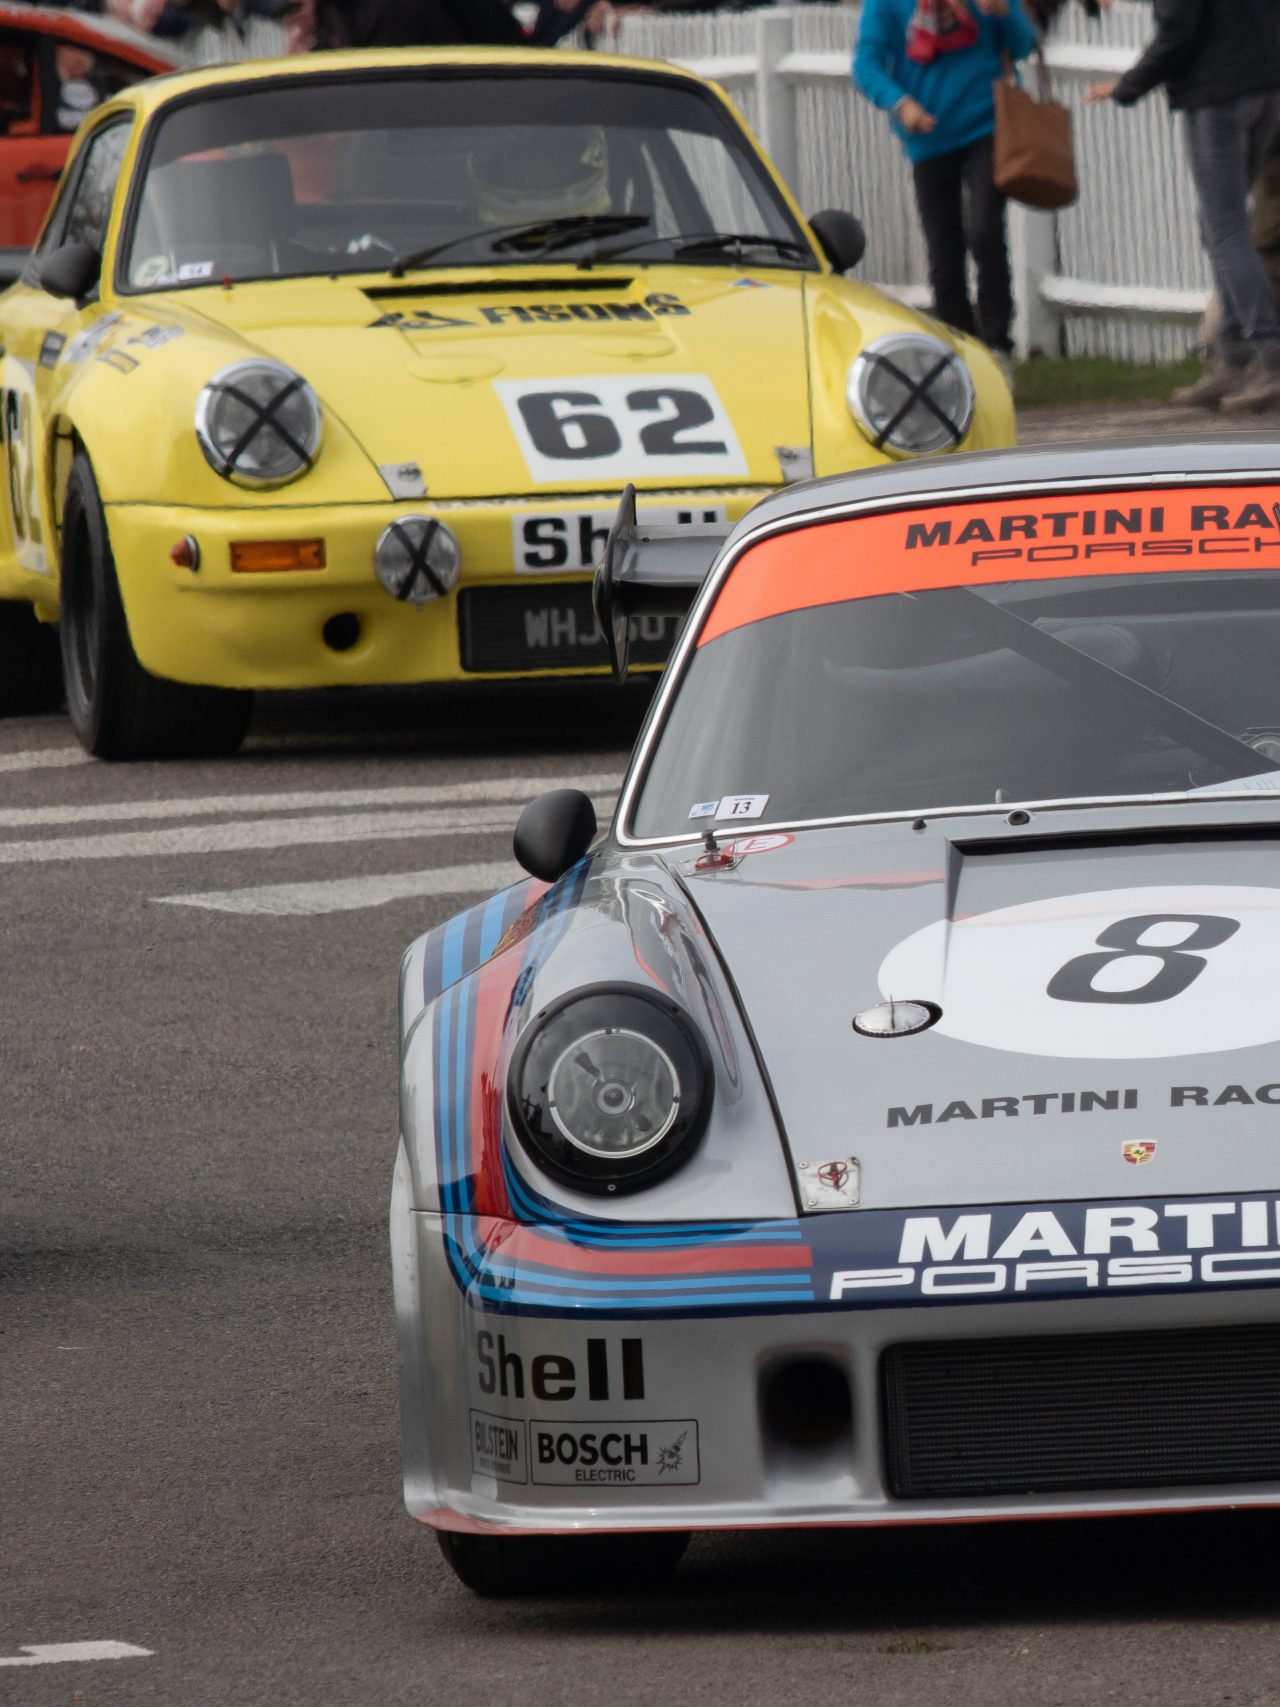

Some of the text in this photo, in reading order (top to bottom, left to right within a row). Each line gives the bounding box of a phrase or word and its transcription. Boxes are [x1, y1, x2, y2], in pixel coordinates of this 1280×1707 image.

[477, 292, 691, 325] FISONS
[516, 388, 729, 460] 62
[905, 505, 1165, 550] MARTINI
[731, 801, 752, 815] 13
[1046, 913, 1241, 1005] 8
[886, 1088, 1139, 1128] MARTINI
[477, 1330, 645, 1401] Shell
[475, 1421, 518, 1461] BILSTEIN
[537, 1432, 649, 1466] BOSCH
[575, 1469, 636, 1482] ELECTRIC
